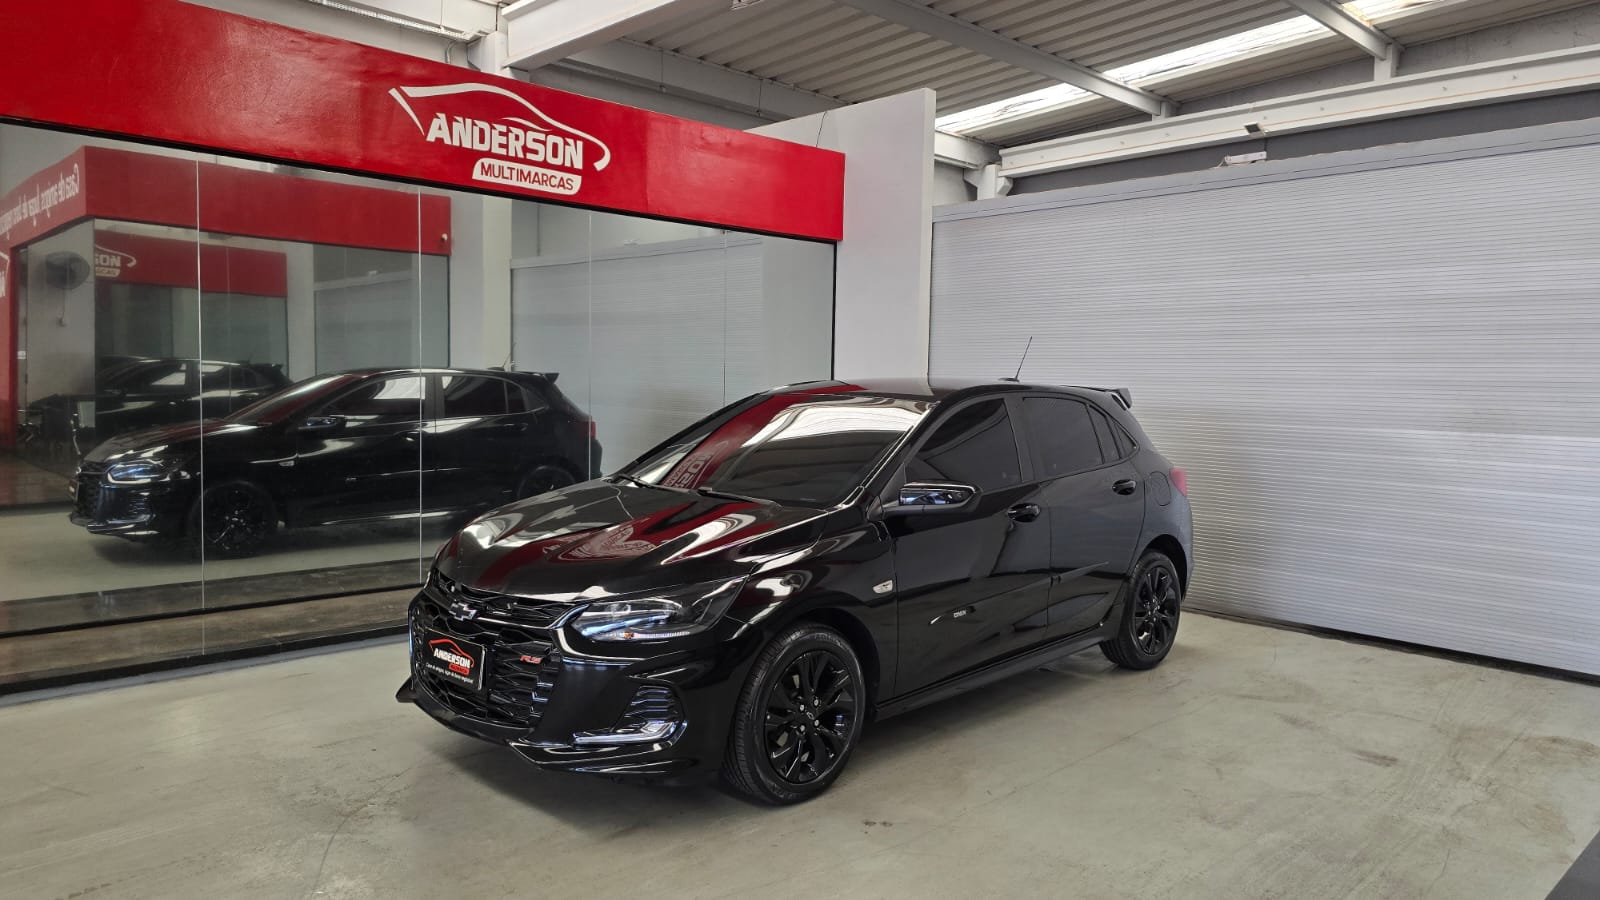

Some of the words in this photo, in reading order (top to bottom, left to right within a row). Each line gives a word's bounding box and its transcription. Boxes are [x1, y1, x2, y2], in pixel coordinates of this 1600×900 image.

[426, 112, 584, 170] ANDERSON
[480, 161, 575, 191] MULTIMARCAS
[433, 647, 471, 669] ANDERSON
